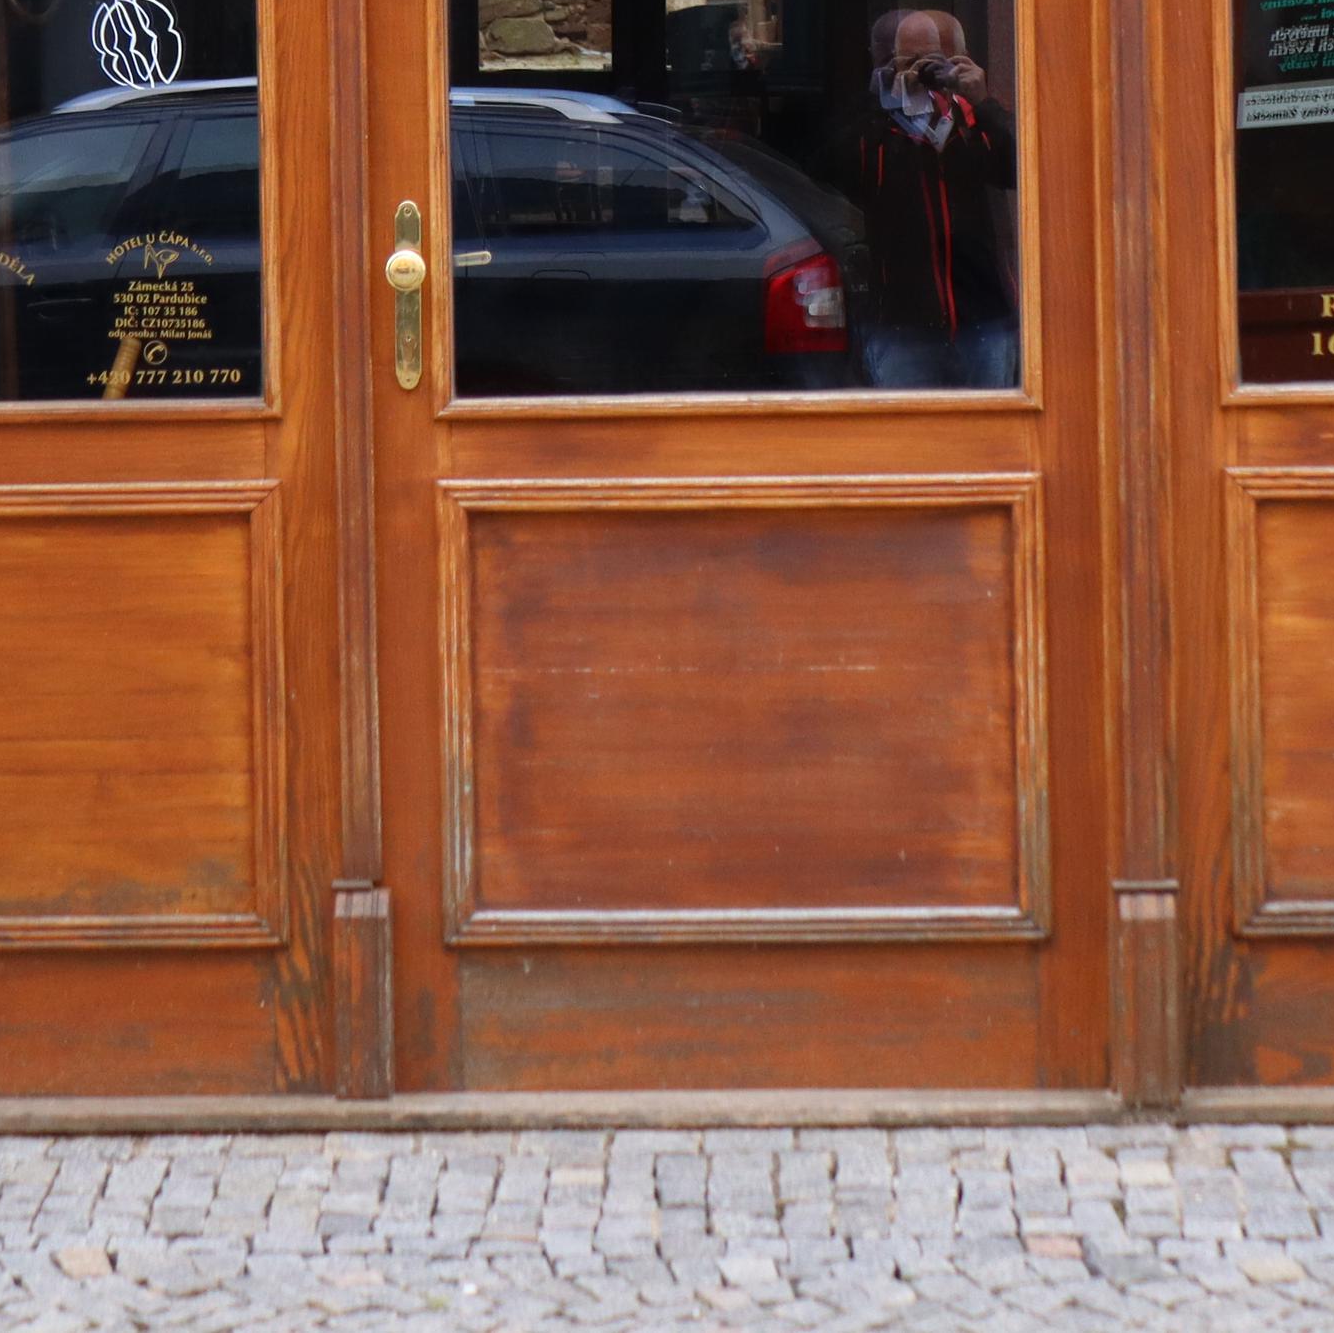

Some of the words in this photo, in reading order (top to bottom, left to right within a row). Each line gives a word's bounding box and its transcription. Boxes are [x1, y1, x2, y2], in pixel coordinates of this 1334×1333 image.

[105, 236, 144, 265] HOTEL
[145, 233, 156, 244] U
[158, 229, 190, 248] ČÁPA
[191, 243, 214, 266] s.r.o.
[128, 280, 178, 292] Zámecká
[180, 281, 195, 292] 25
[113, 293, 134, 304] 530
[136, 293, 150, 304] 02
[152, 292, 208, 304] Pardubice
[142, 306, 160, 316] 107
[162, 306, 177, 316] 35
[179, 306, 198, 316] 186
[114, 315, 139, 328] DIČ:
[141, 318, 206, 329] CZ10735186
[160, 330, 186, 339] Milan
[187, 330, 212, 340] Jonáš
[86, 370, 131, 385] +420
[136, 370, 167, 385] 777
[172, 370, 204, 384] 210
[209, 369, 242, 384] 770
